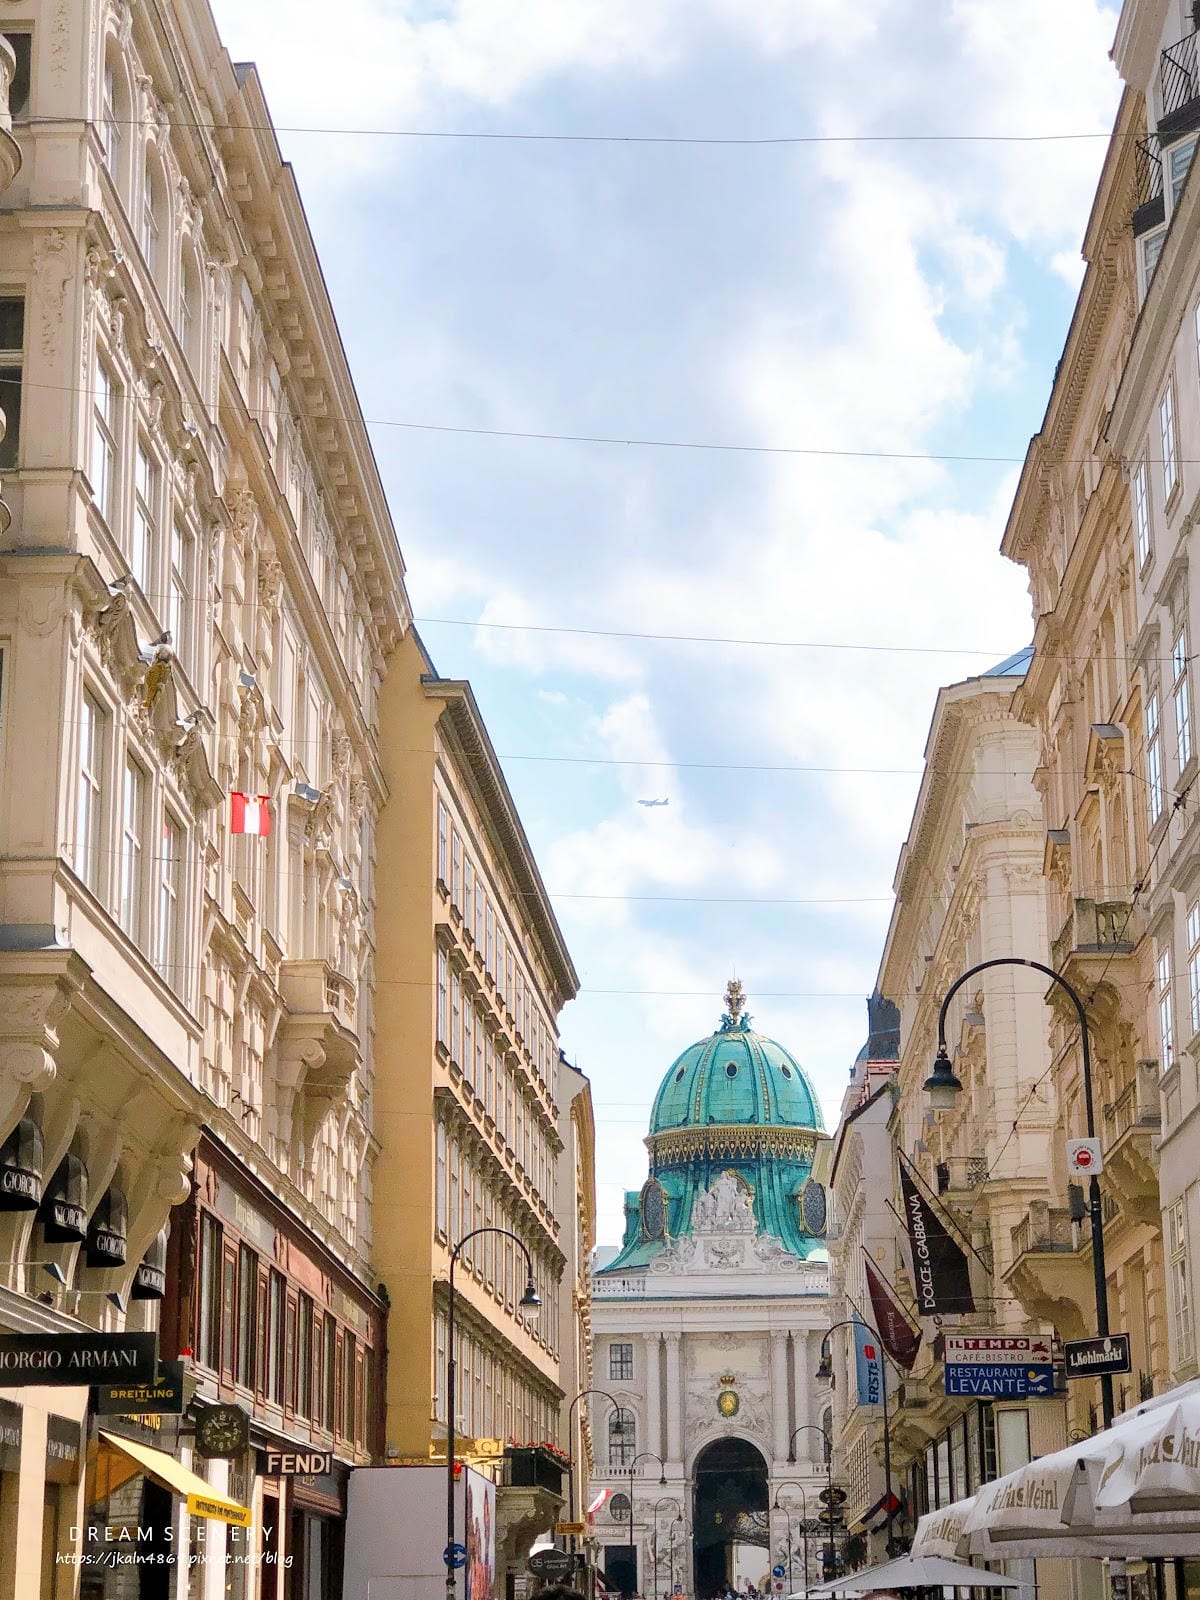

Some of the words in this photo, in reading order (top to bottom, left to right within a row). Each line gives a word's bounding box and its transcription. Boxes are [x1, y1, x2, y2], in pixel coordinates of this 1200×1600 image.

[909, 1194, 929, 1260] GABBANA
[920, 1266, 937, 1308] DOLCE
[949, 1339, 964, 1349] IL
[966, 1339, 1028, 1349] TEMPO
[69, 1350, 137, 1368] ARMANI
[955, 1351, 1024, 1362] CAFÉ-BISTRO
[949, 1367, 1025, 1378] RESTAURANT
[867, 1361, 880, 1403] ERSTE
[949, 1379, 1026, 1393] LEVANTE
[110, 1389, 174, 1399] BREITLING
[267, 1454, 331, 1474] FENDI
